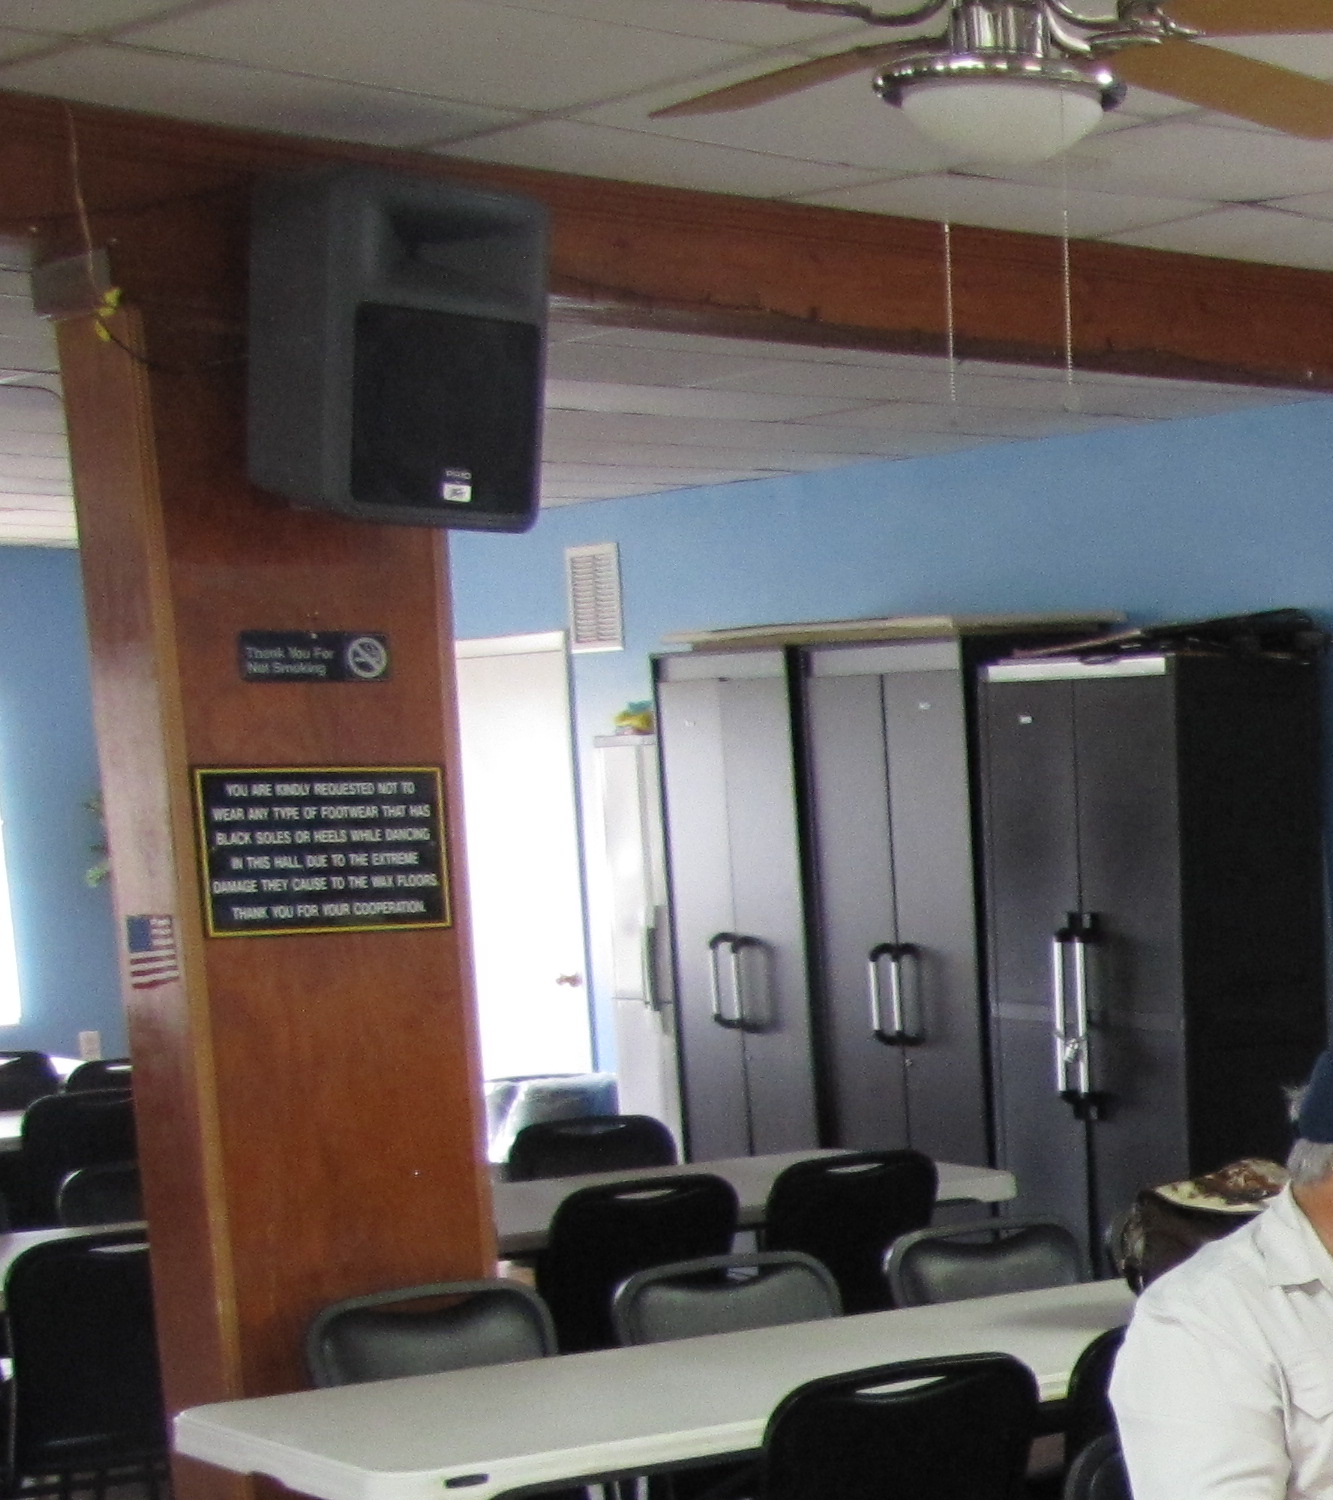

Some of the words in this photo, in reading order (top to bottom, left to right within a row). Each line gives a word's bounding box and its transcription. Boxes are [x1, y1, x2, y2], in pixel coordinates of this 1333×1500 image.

[246, 647, 285, 659] Thank
[287, 647, 310, 659] You
[312, 647, 334, 659] For
[247, 662, 269, 673] Not
[273, 662, 326, 676] Smoking
[226, 783, 247, 797] YOU
[251, 783, 272, 796] ARE
[275, 783, 311, 796] KINDLY
[314, 782, 374, 796] REQUESTED
[378, 782, 399, 795] NOT
[401, 782, 415, 794] TO
[212, 807, 243, 821] WEAR
[248, 807, 269, 820] ANY
[273, 806, 300, 820] TYPE
[303, 806, 318, 819] OF
[321, 805, 379, 819] FOOTWEAR
[382, 805, 406, 818] THAT
[409, 805, 430, 818] HAS
[215, 832, 252, 845] BLACK
[256, 831, 291, 845] SOLES
[295, 830, 310, 844] OR
[314, 830, 347, 843] HEELS
[350, 829, 382, 842] WHILE
[385, 828, 430, 841] DANCING
[231, 856, 243, 870] IN
[247, 855, 271, 869] THIS
[306, 854, 328, 868] DUE
[331, 854, 346, 867] TO
[348, 853, 368, 866] THE
[371, 852, 419, 866] EXTREME
[213, 880, 258, 894] DAMAGE
[262, 879, 289, 892] THEY
[292, 878, 328, 891] CAUSE
[330, 877, 345, 890] TO
[348, 877, 368, 889] THE
[371, 876, 394, 888] WAX
[231, 907, 268, 921] THANK
[272, 906, 294, 919] YOU
[297, 905, 319, 918] FOR
[321, 904, 350, 917] YOUR
[353, 900, 426, 916] COOPERATION.
